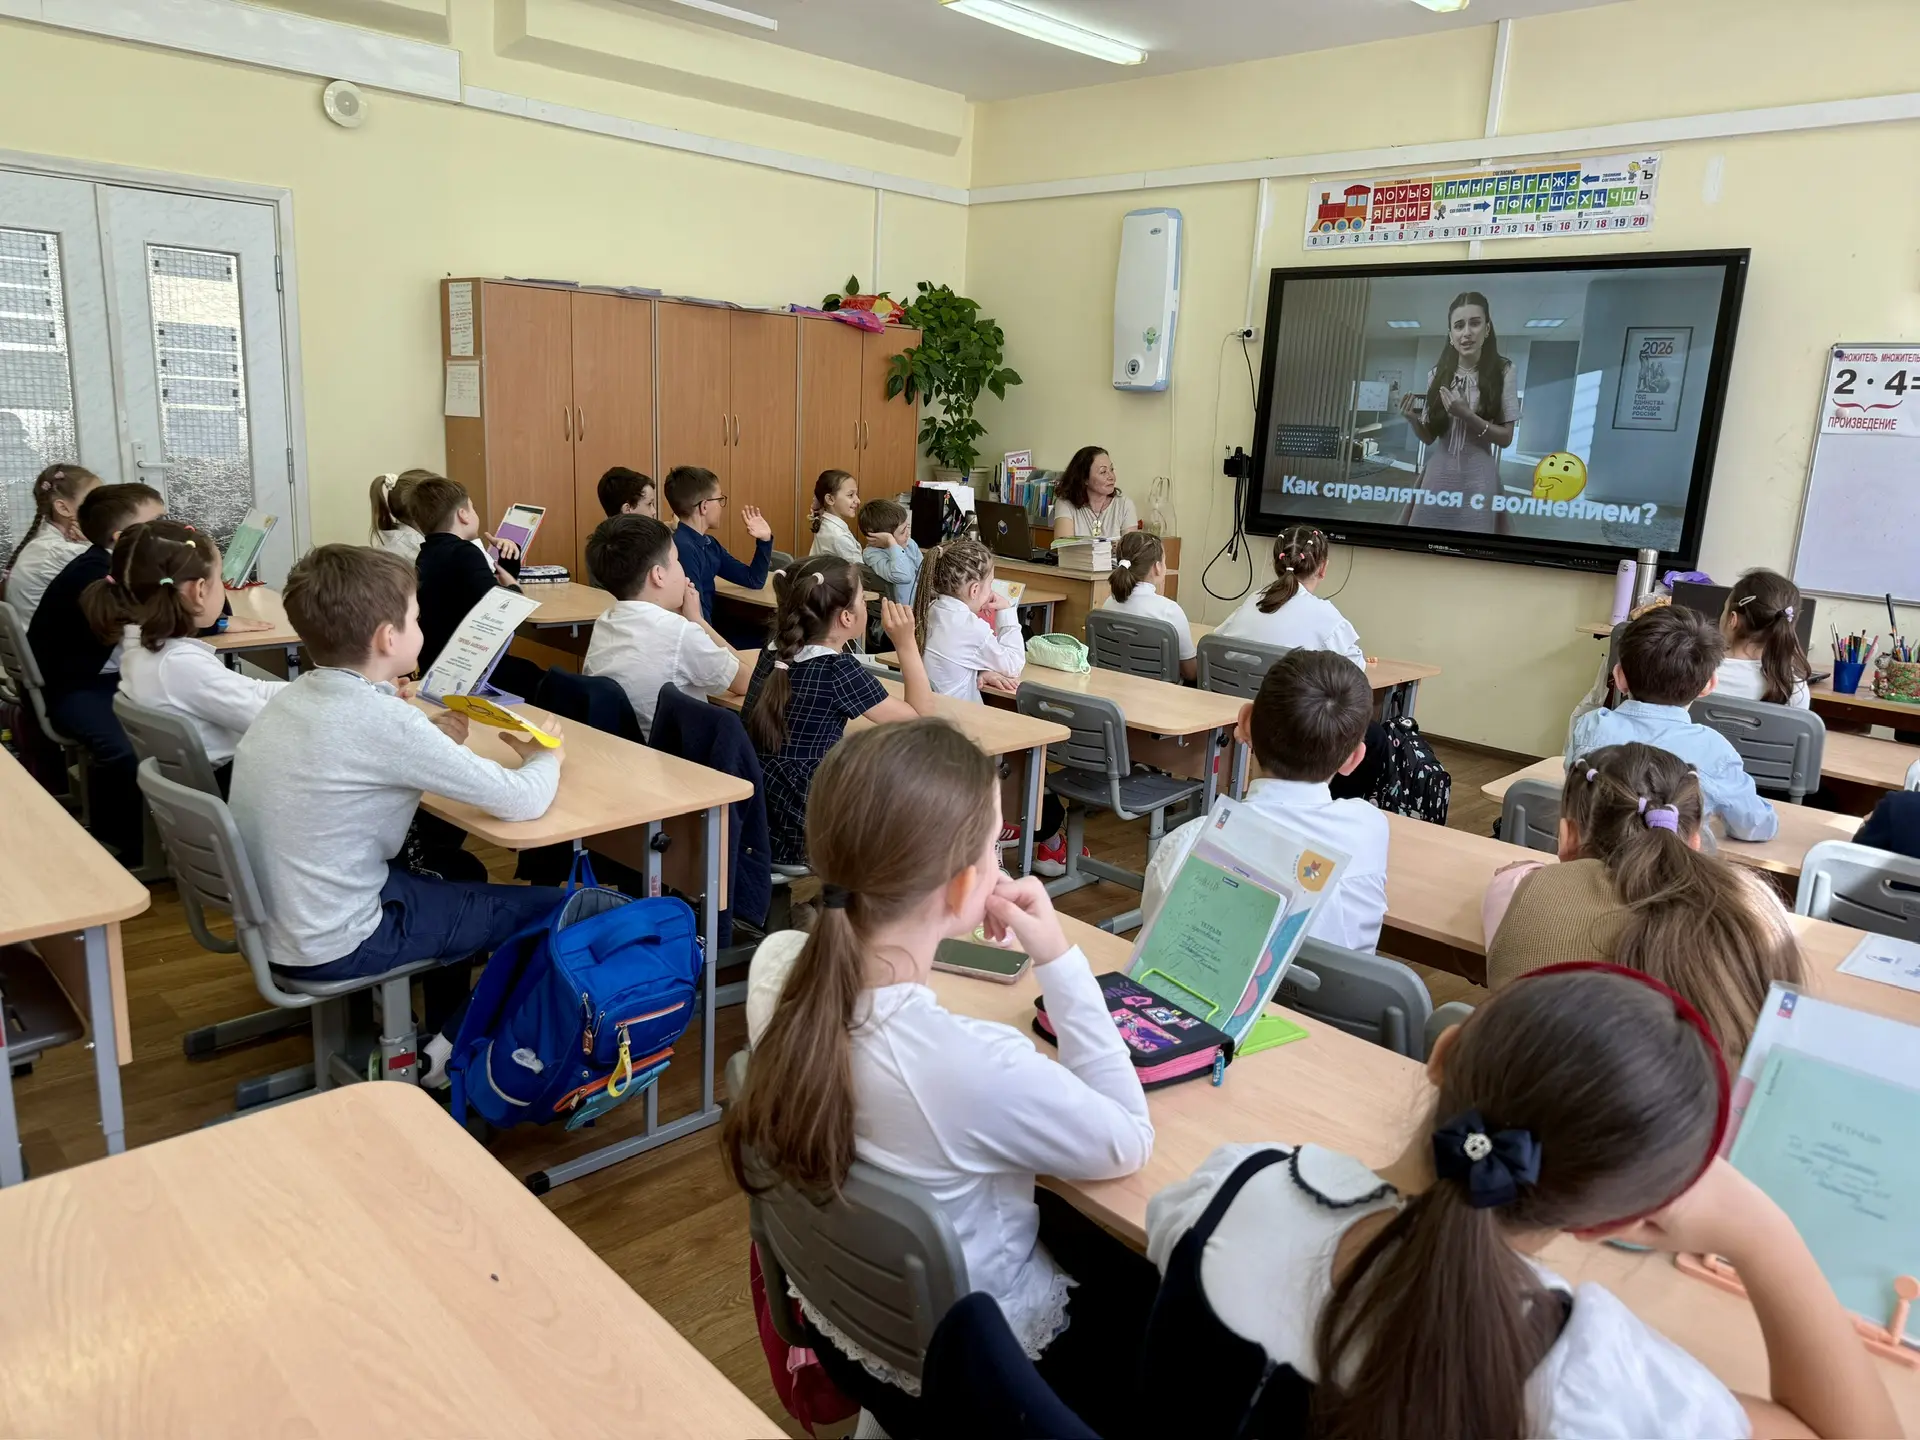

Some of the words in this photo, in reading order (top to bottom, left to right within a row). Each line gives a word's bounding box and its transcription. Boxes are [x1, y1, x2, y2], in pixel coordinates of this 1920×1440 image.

[1428, 230, 1433, 238] 8
[1458, 228, 1467, 236] 10
[1473, 227, 1482, 235] 11
[1490, 226, 1500, 234] 12
[1524, 224, 1535, 232] 14
[1542, 223, 1552, 231] 15
[1559, 222, 1570, 230] 16
[1578, 221, 1588, 229] 17
[1596, 220, 1607, 228] 18
[1615, 218, 1626, 227] 19
[1632, 217, 1644, 226] 20
[1642, 341, 1674, 355] 2026
[1839, 353, 1878, 362] НОЖИТЕЛЬ
[1833, 369, 1857, 394] 2
[1884, 370, 1908, 396] 4
[1827, 416, 1898, 431] ПРОИЗВЕДЕНИЕ
[1282, 475, 1319, 496] Как
[1322, 481, 1463, 508] справляться
[1470, 494, 1484, 510] с
[1491, 495, 1658, 525] волнением?
